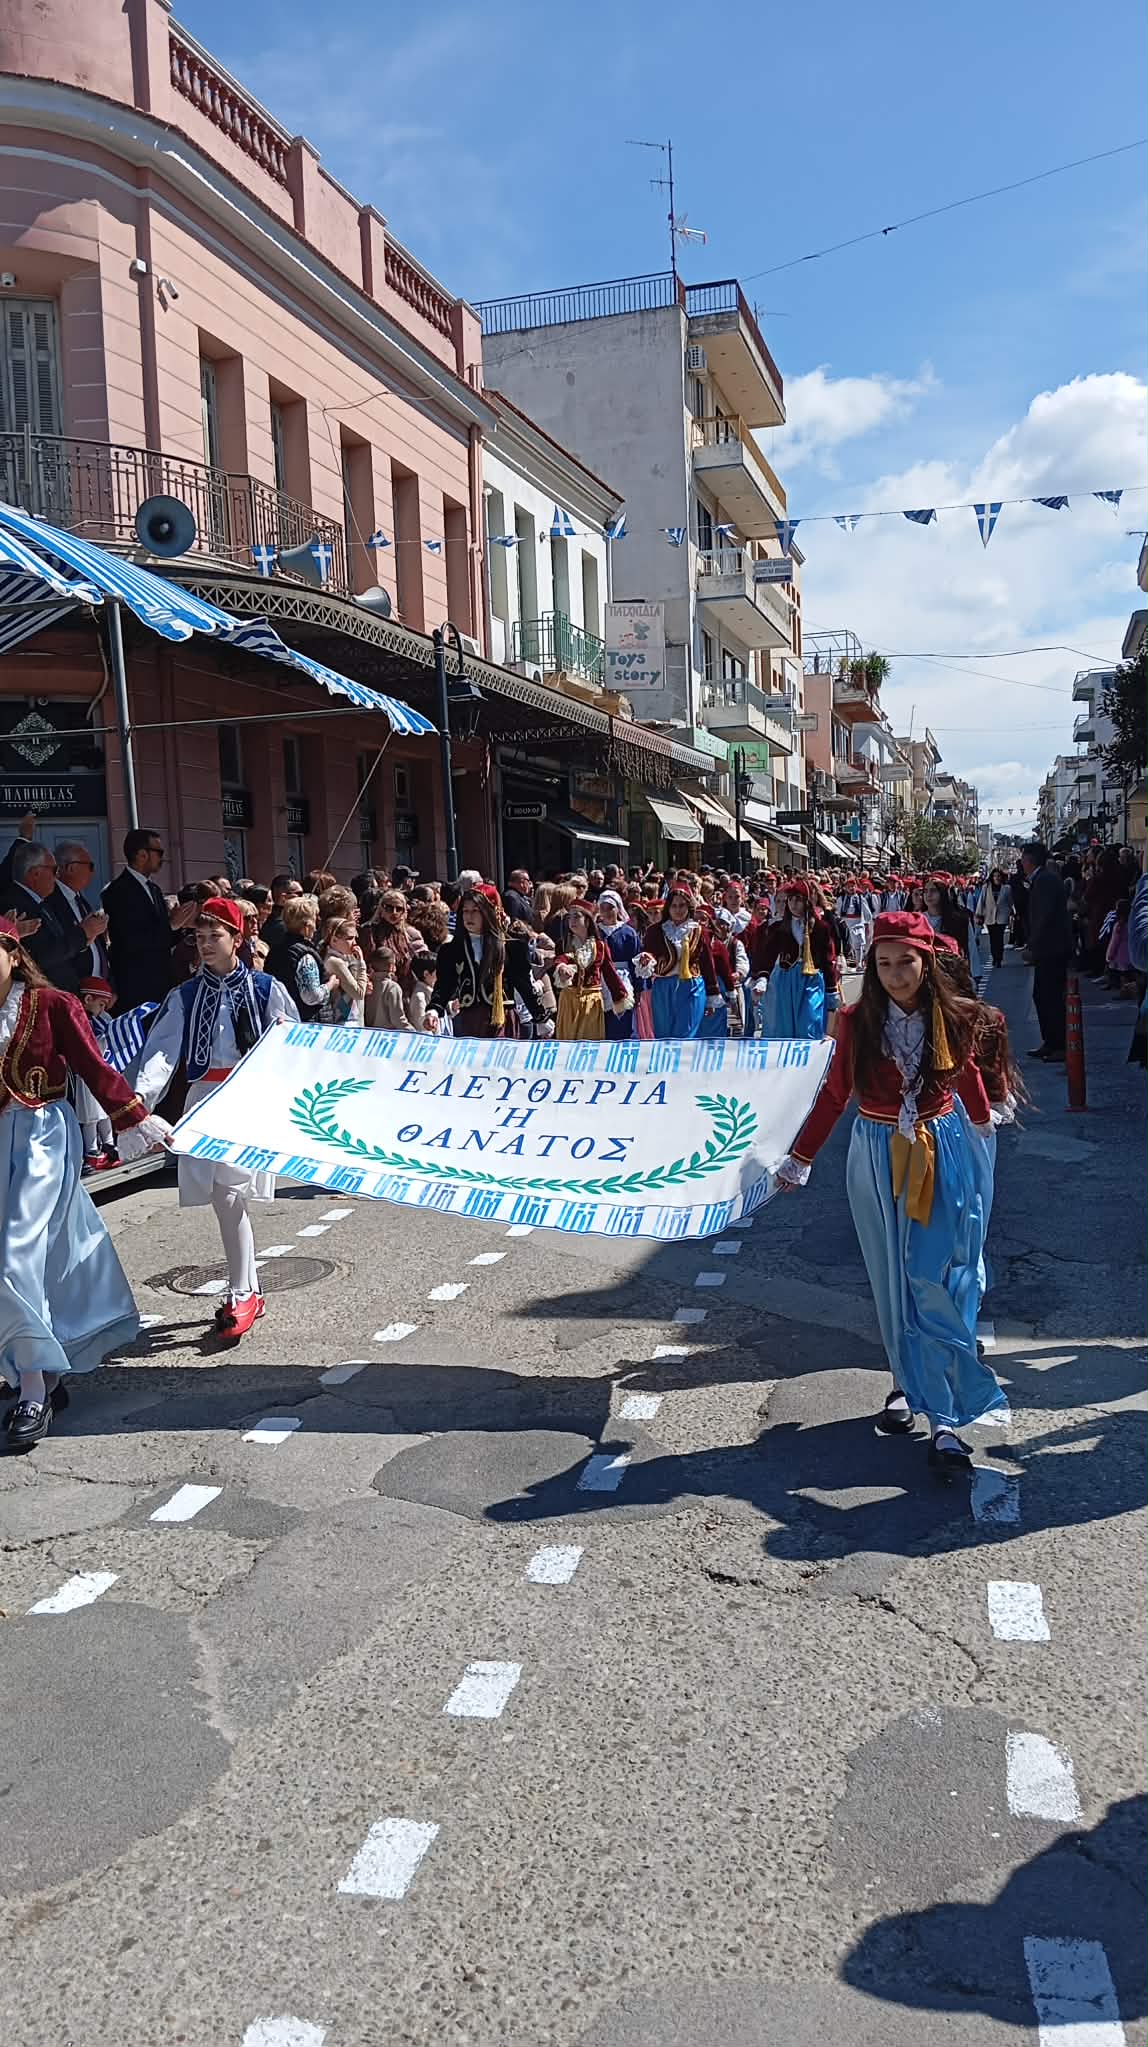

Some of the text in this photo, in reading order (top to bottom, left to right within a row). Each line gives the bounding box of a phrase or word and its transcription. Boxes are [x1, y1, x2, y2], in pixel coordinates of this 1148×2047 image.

[607, 652, 646, 668] Toys
[614, 670, 661, 685] story
[394, 1069, 668, 1105] ΕΛΕΥΘΕΡΙΑ
[396, 1123, 635, 1162] ΘΑΝΑΤΟΣ
